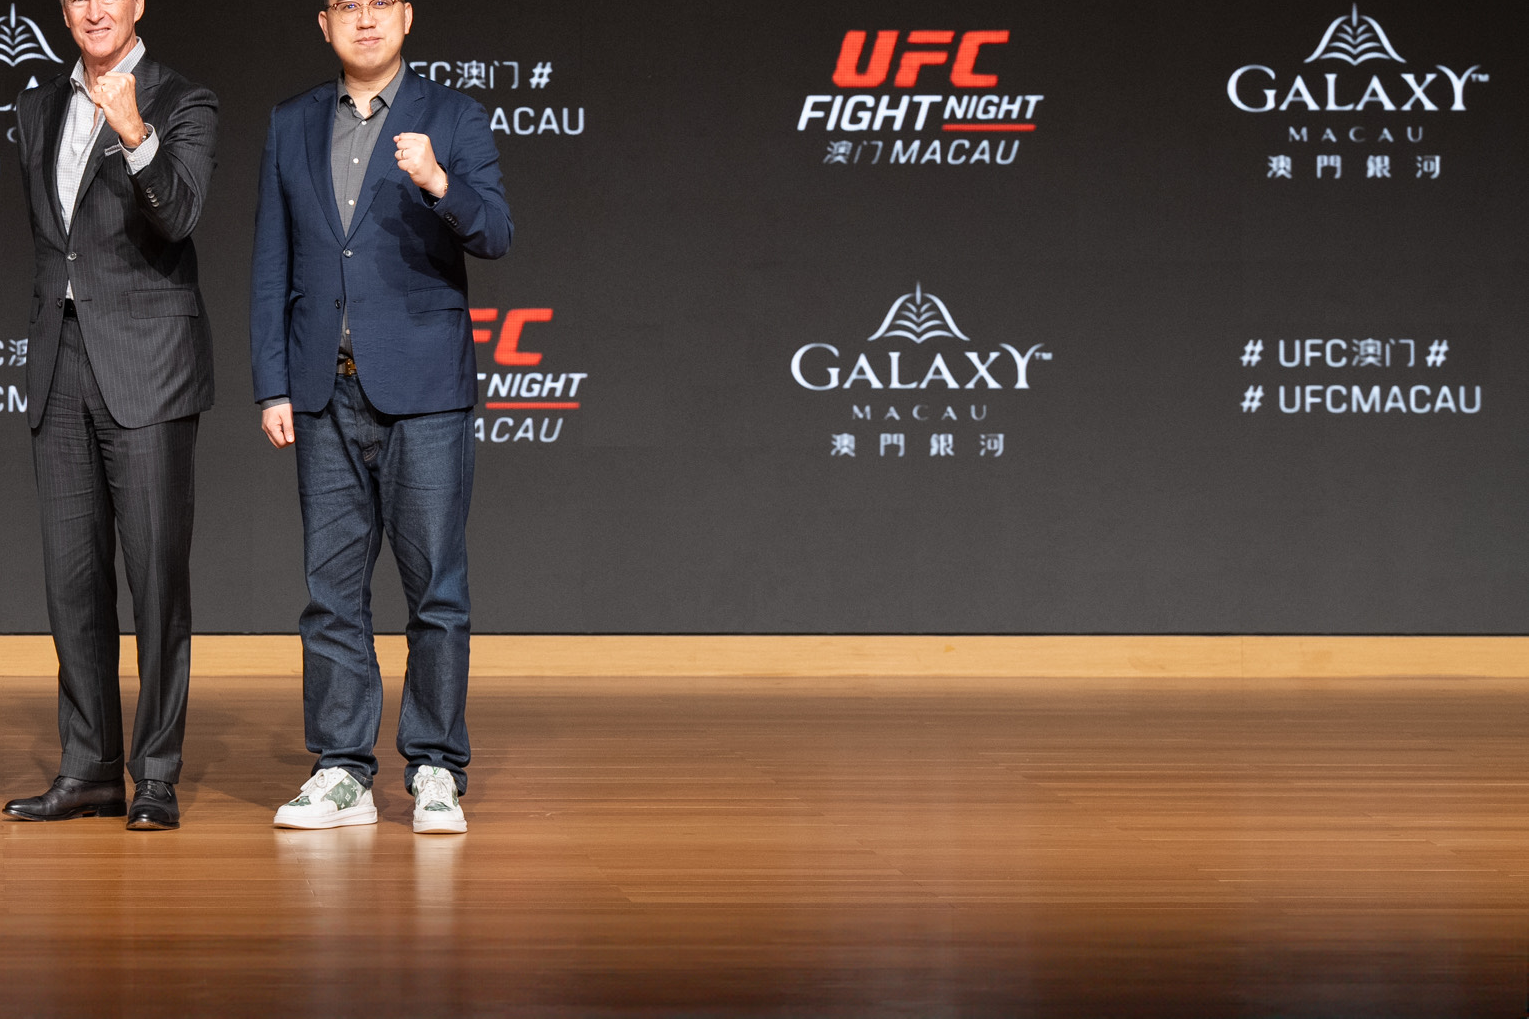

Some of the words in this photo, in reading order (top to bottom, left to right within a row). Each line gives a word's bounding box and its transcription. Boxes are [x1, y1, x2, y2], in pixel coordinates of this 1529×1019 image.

[832, 30, 1010, 88] UFC
[529, 62, 553, 89] #
[797, 95, 942, 131] FIGHT
[943, 95, 1044, 119] NIGHT
[1289, 127, 1422, 142] MACAU
[824, 140, 883, 164] 澳门
[890, 139, 1019, 164] MACAU
[1267, 155, 1440, 179] 澳門銀河
[1240, 340, 1263, 366] #
[1426, 340, 1449, 367] #
[487, 373, 588, 397] NIGHT
[1241, 385, 1264, 412] #
[1279, 385, 1481, 413] UFCMACAU
[853, 405, 986, 420] MACAU
[475, 417, 563, 442] ACAU
[831, 433, 1004, 457] 澳門銀河
